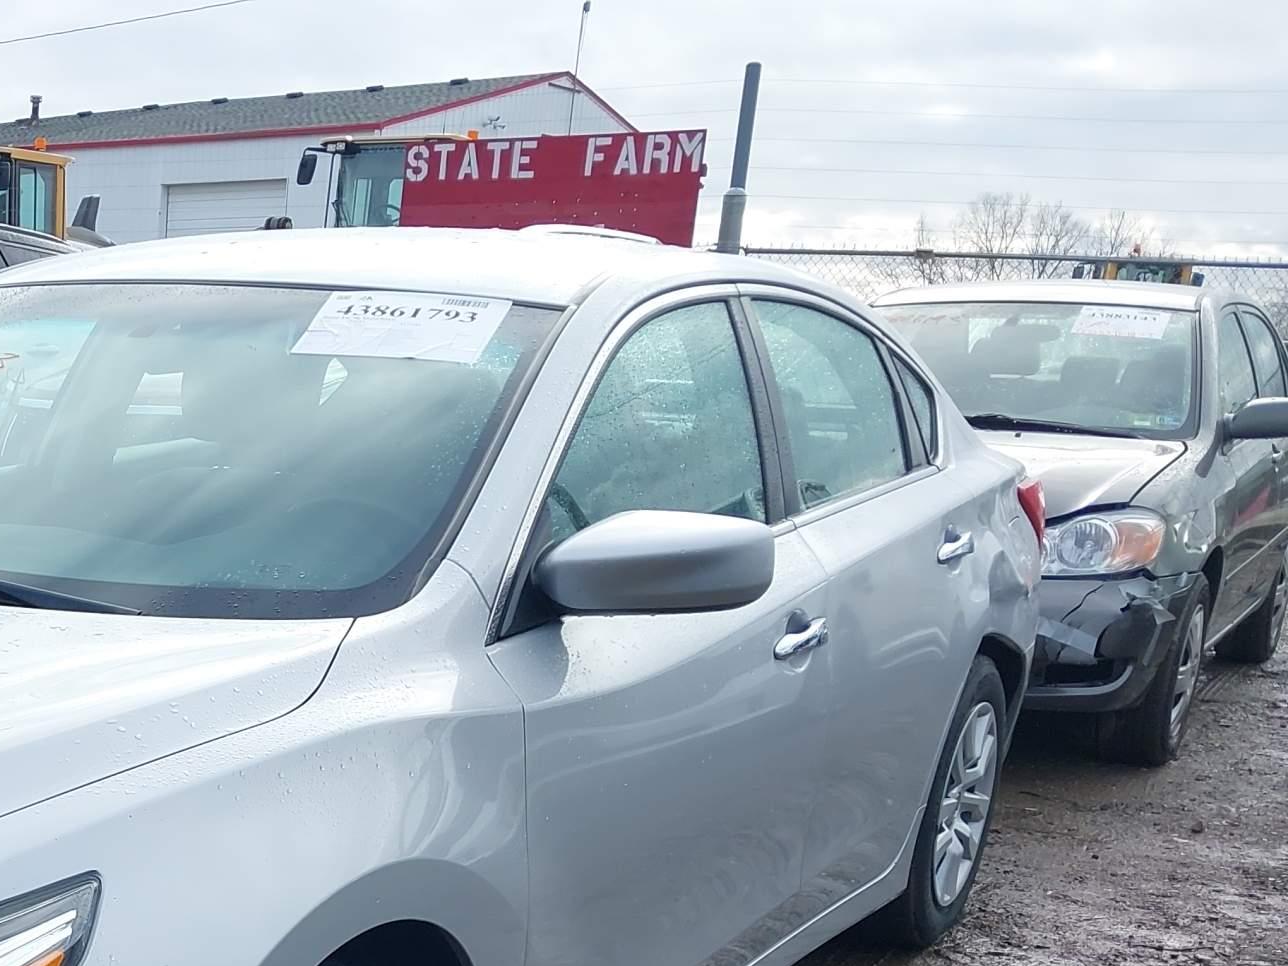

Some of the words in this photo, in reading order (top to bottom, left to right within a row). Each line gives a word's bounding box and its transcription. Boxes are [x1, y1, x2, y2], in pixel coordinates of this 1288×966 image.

[405, 139, 538, 182] STATE
[583, 131, 705, 177] FARM
[336, 302, 479, 325] 43861793
